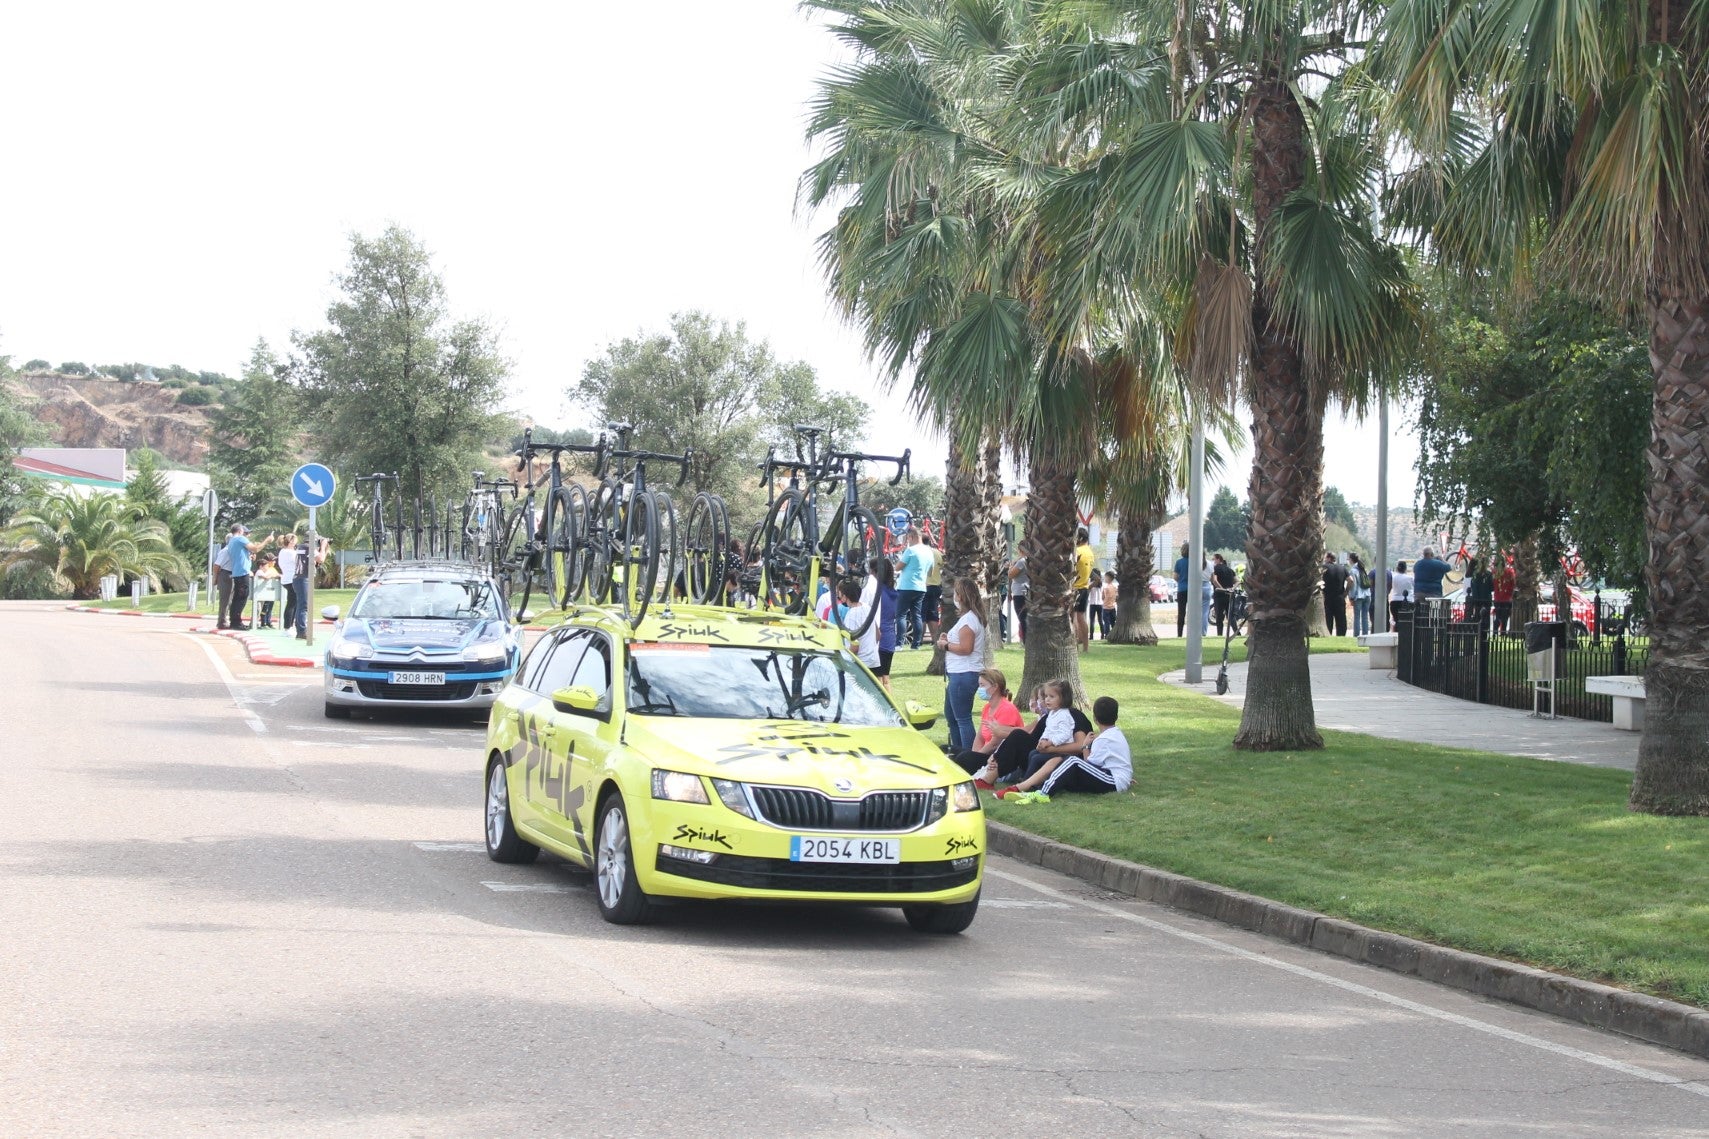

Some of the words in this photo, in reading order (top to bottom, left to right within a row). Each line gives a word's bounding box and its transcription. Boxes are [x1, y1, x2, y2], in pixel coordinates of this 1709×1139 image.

[657, 623, 729, 642] Spiuk
[758, 628, 825, 648] Spiuk
[396, 673, 420, 683] 2908
[424, 673, 443, 684] HRN
[672, 823, 733, 850] Spiuk
[945, 836, 978, 856] Spiuk
[803, 839, 852, 859] 2054
[860, 841, 895, 860] KBL
